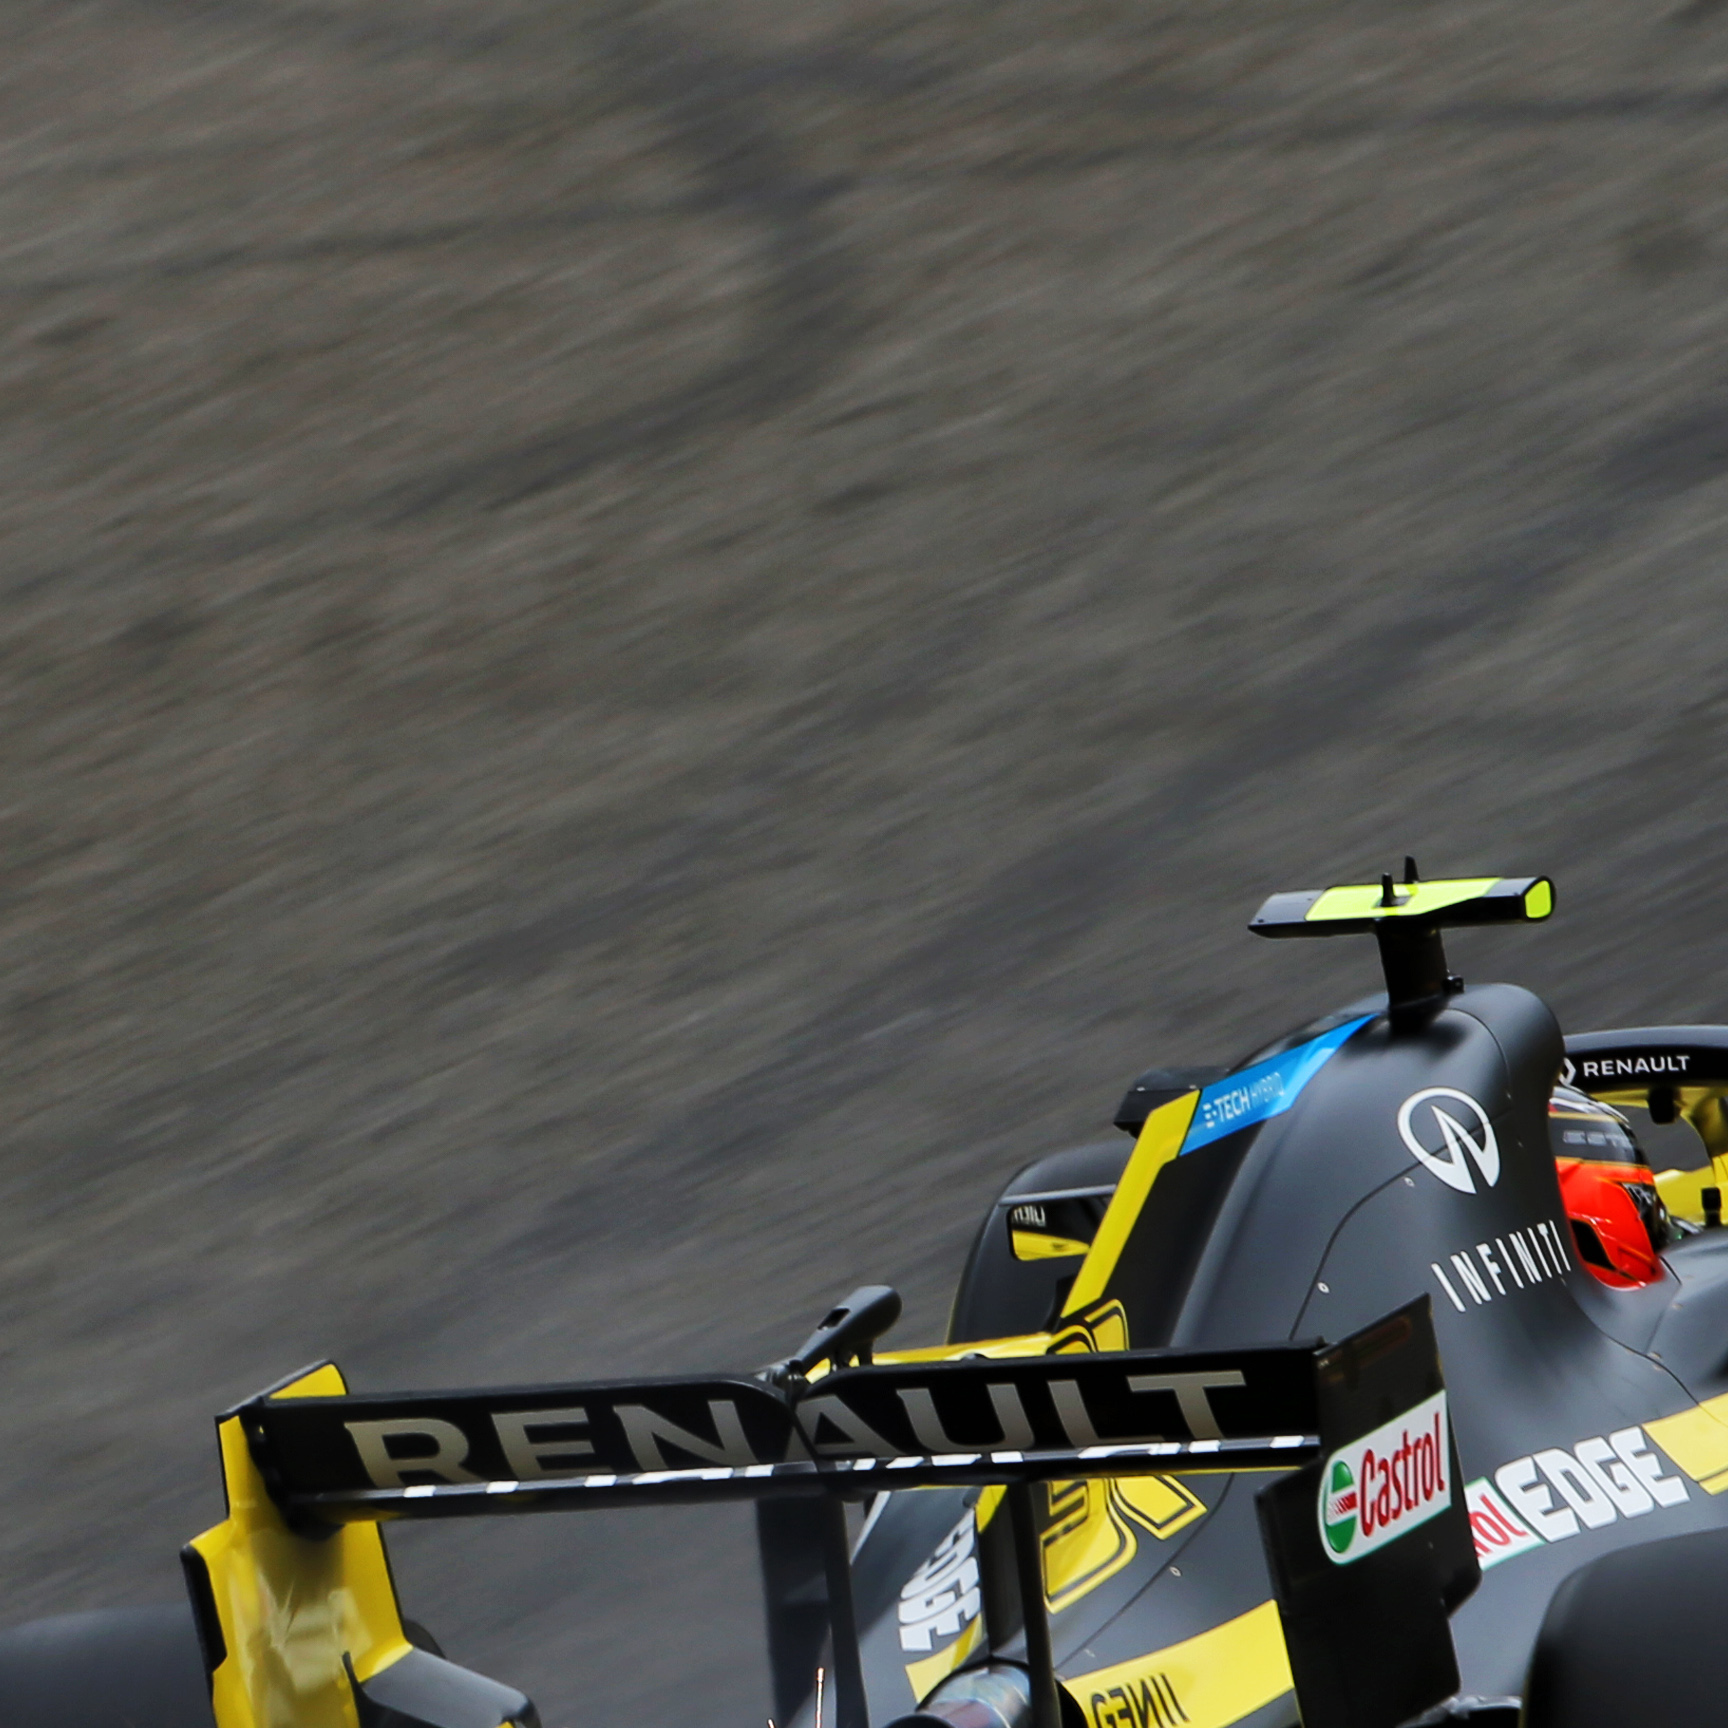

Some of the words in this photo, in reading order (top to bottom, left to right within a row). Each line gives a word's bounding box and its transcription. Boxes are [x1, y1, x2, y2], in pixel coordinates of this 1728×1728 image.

[1582, 1055, 1690, 1077] RENAULT
[1430, 1219, 1571, 1313] INFINITI
[343, 1370, 1246, 1492] RENAULT
[1359, 1410, 1445, 1538] Castrol
[1494, 1425, 1691, 1543] EDGE
